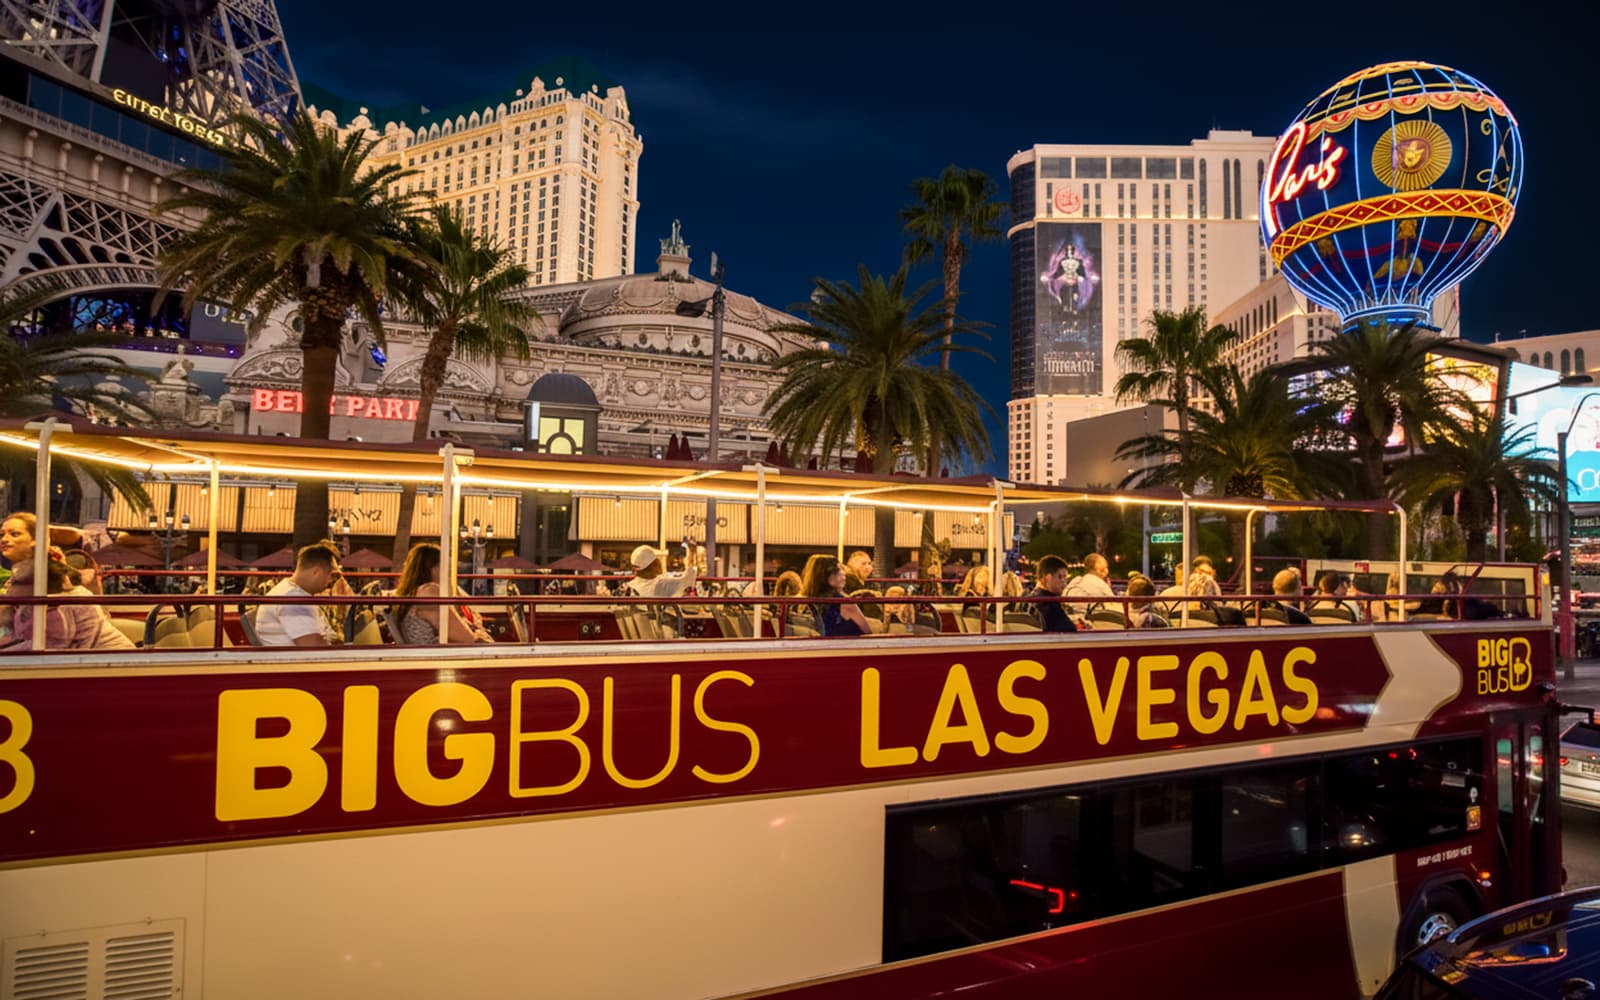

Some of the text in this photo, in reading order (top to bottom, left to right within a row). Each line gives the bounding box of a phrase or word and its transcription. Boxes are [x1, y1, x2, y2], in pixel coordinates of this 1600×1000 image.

[253, 388, 336, 416] BE
[1477, 637, 1509, 668] BIG
[1477, 668, 1510, 695] BUS
[861, 659, 1049, 768] LAS
[1078, 646, 1320, 745] VEGAS
